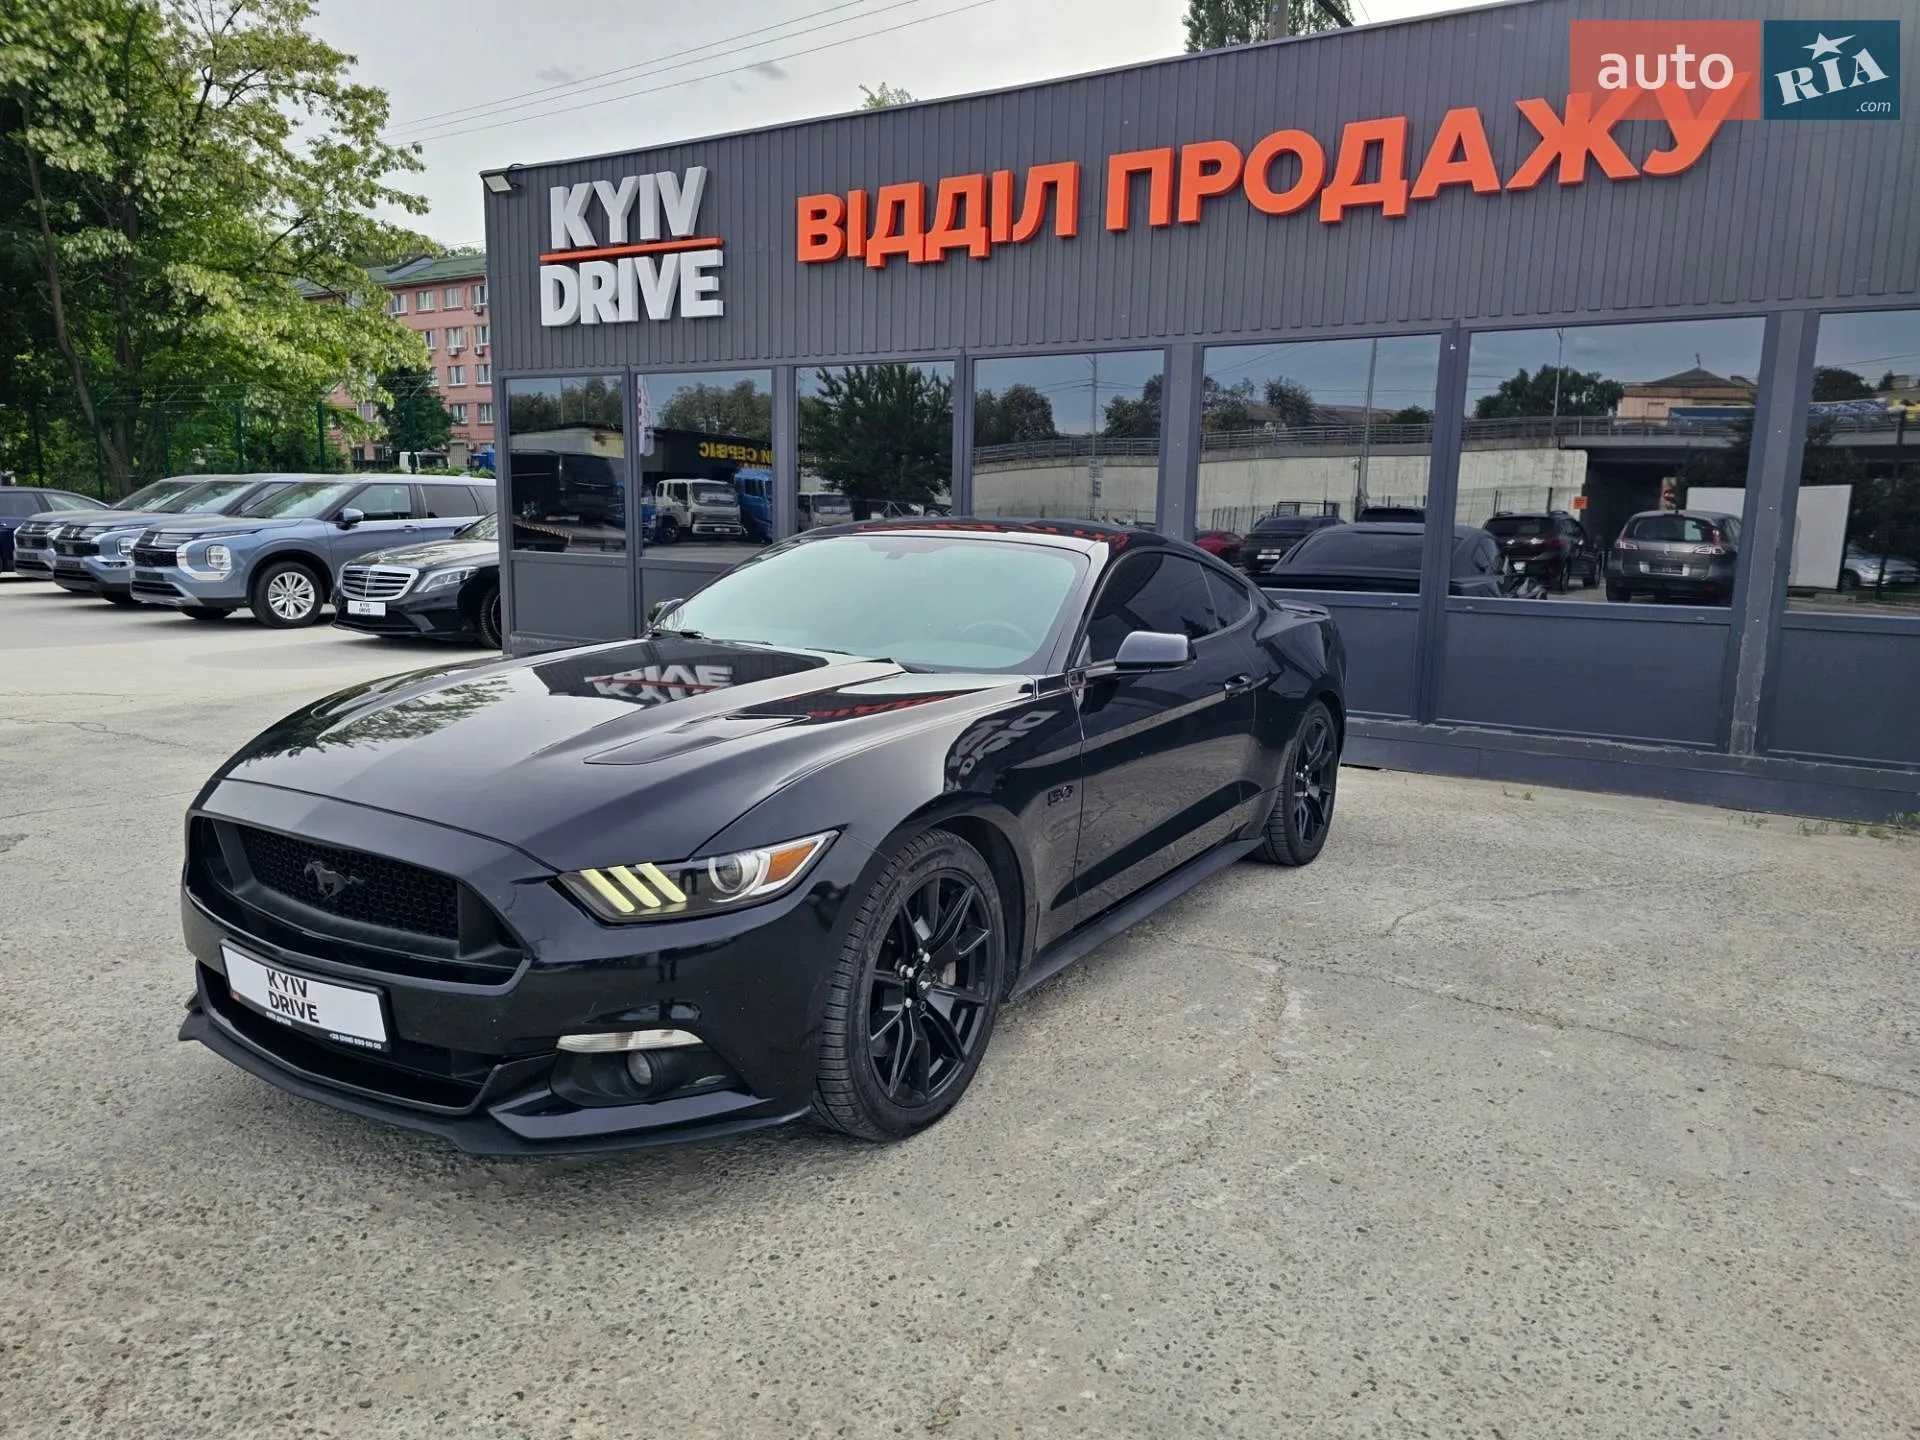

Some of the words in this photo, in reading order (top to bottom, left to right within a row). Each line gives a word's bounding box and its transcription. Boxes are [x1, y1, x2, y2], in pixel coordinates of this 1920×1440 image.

[550, 166, 708, 250] KYIV
[797, 160, 1080, 268] ВІДДІЛ
[1106, 71, 1752, 231] ПРОДАЖУ
[540, 249, 724, 327] DRIVE
[266, 968, 308, 998] KYIV
[268, 990, 320, 1024] DRIVE
